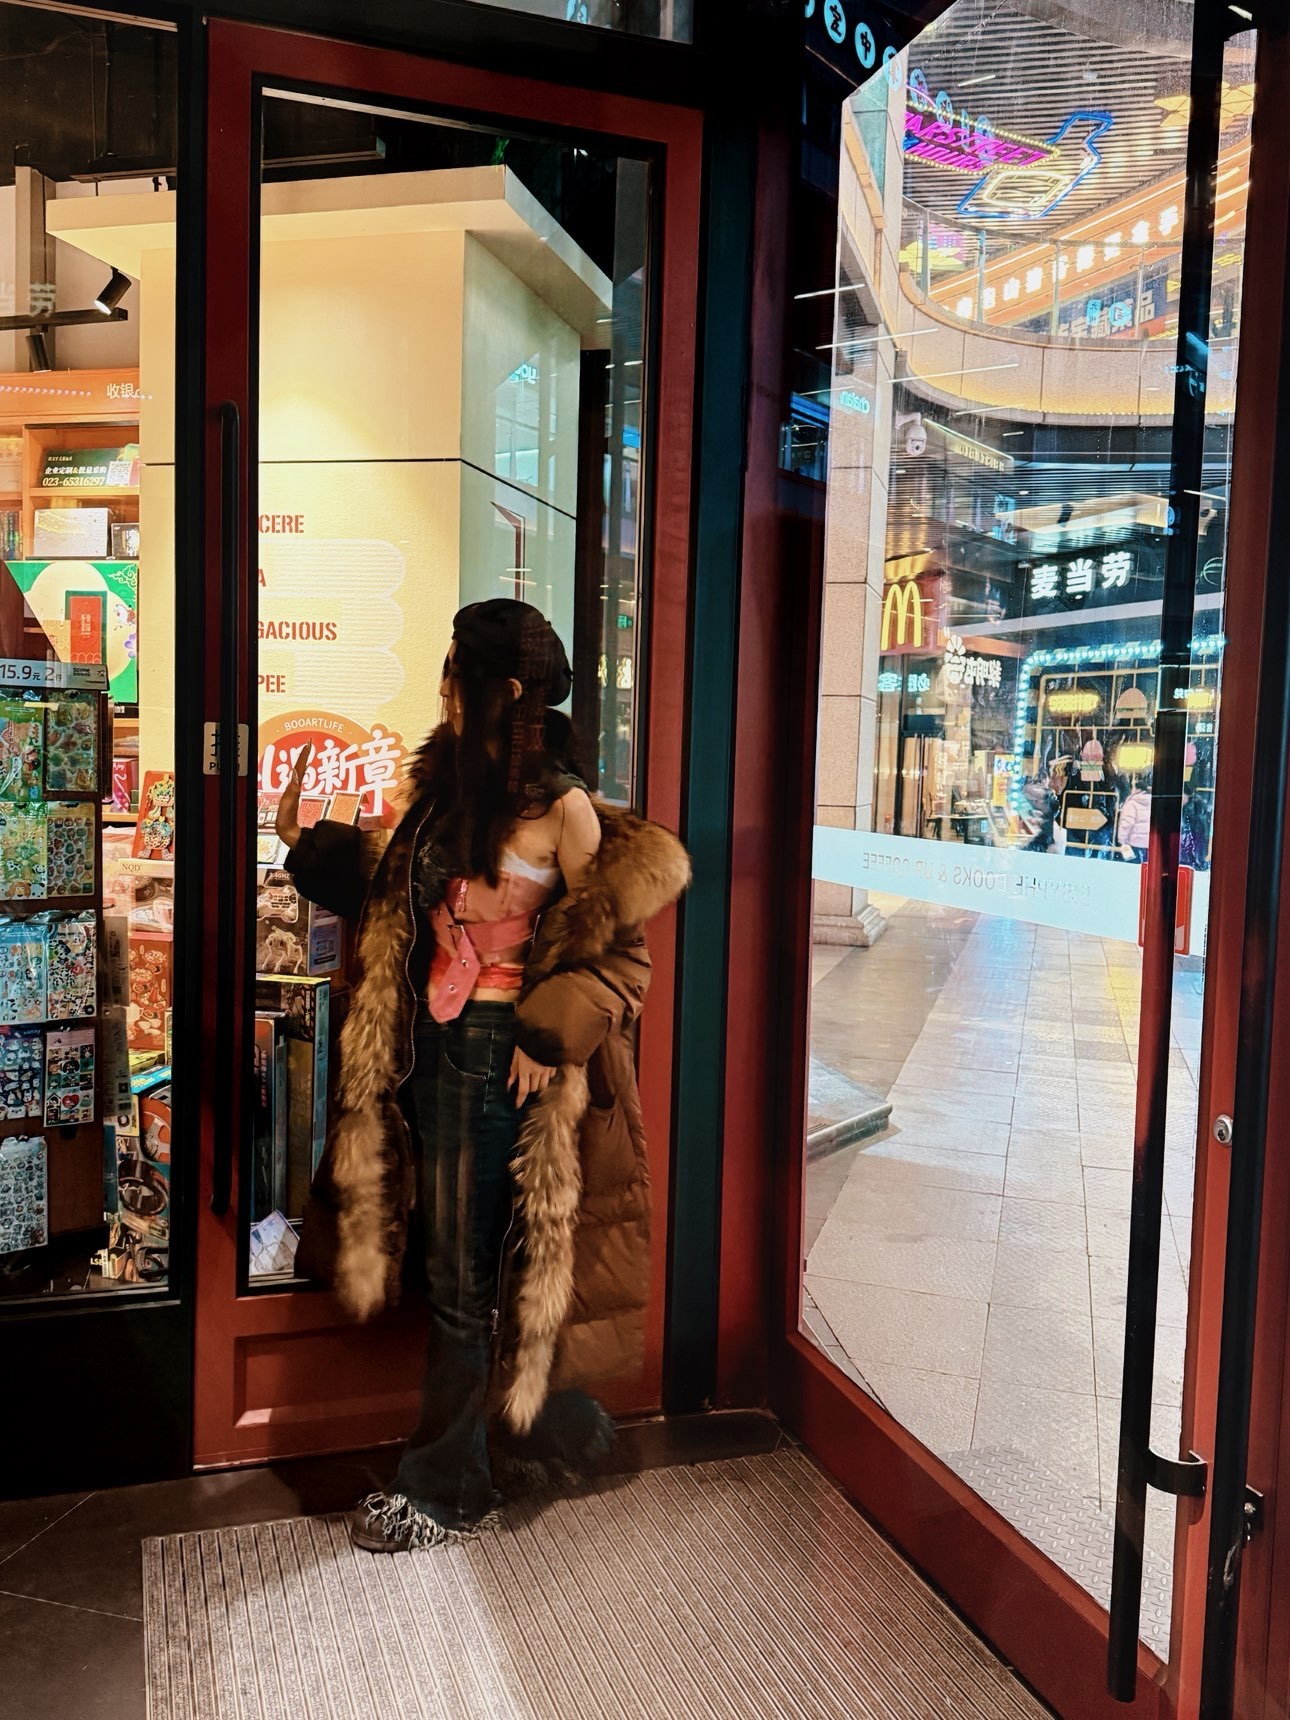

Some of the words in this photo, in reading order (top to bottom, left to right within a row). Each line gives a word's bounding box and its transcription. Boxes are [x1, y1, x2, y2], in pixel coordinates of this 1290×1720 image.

[42, 477, 105, 487] 023-65316297
[1031, 551, 1131, 599] 麦当劳
[284, 717, 345, 733] BOOARTLIFE
